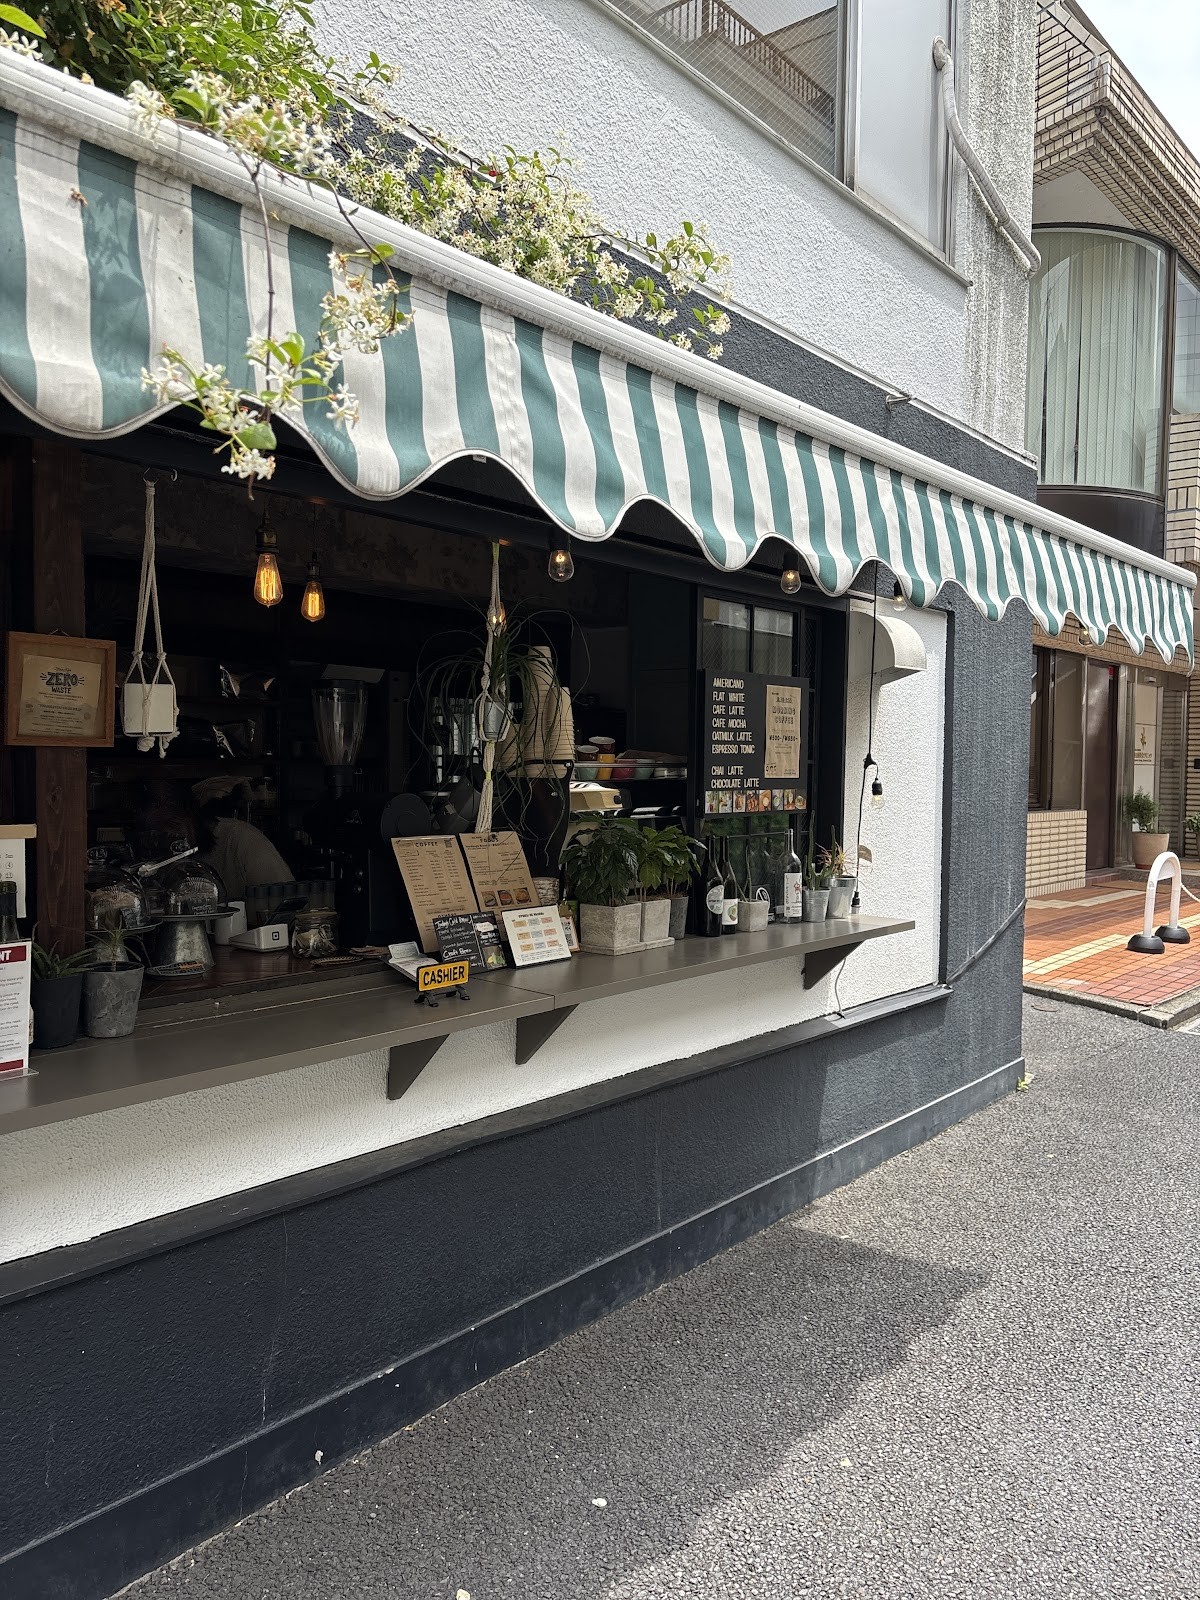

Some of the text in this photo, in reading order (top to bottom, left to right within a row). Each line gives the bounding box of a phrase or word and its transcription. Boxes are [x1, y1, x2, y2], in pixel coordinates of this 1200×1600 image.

[46, 672, 79, 687] ZERO
[713, 677, 744, 689] AMERICANO
[712, 691, 745, 702] FLAT WHITE
[712, 704, 745, 715] CAFE LATTE
[712, 717, 747, 728] CAFE MOCHA
[712, 731, 752, 741] OATMILK LATTE
[711, 744, 755, 754] ESPRESSO TONIC
[711, 765, 743, 776] CHAI LATTE
[711, 777, 759, 789] CHOCOLATE LATTE
[423, 965, 465, 986] CASHIER
